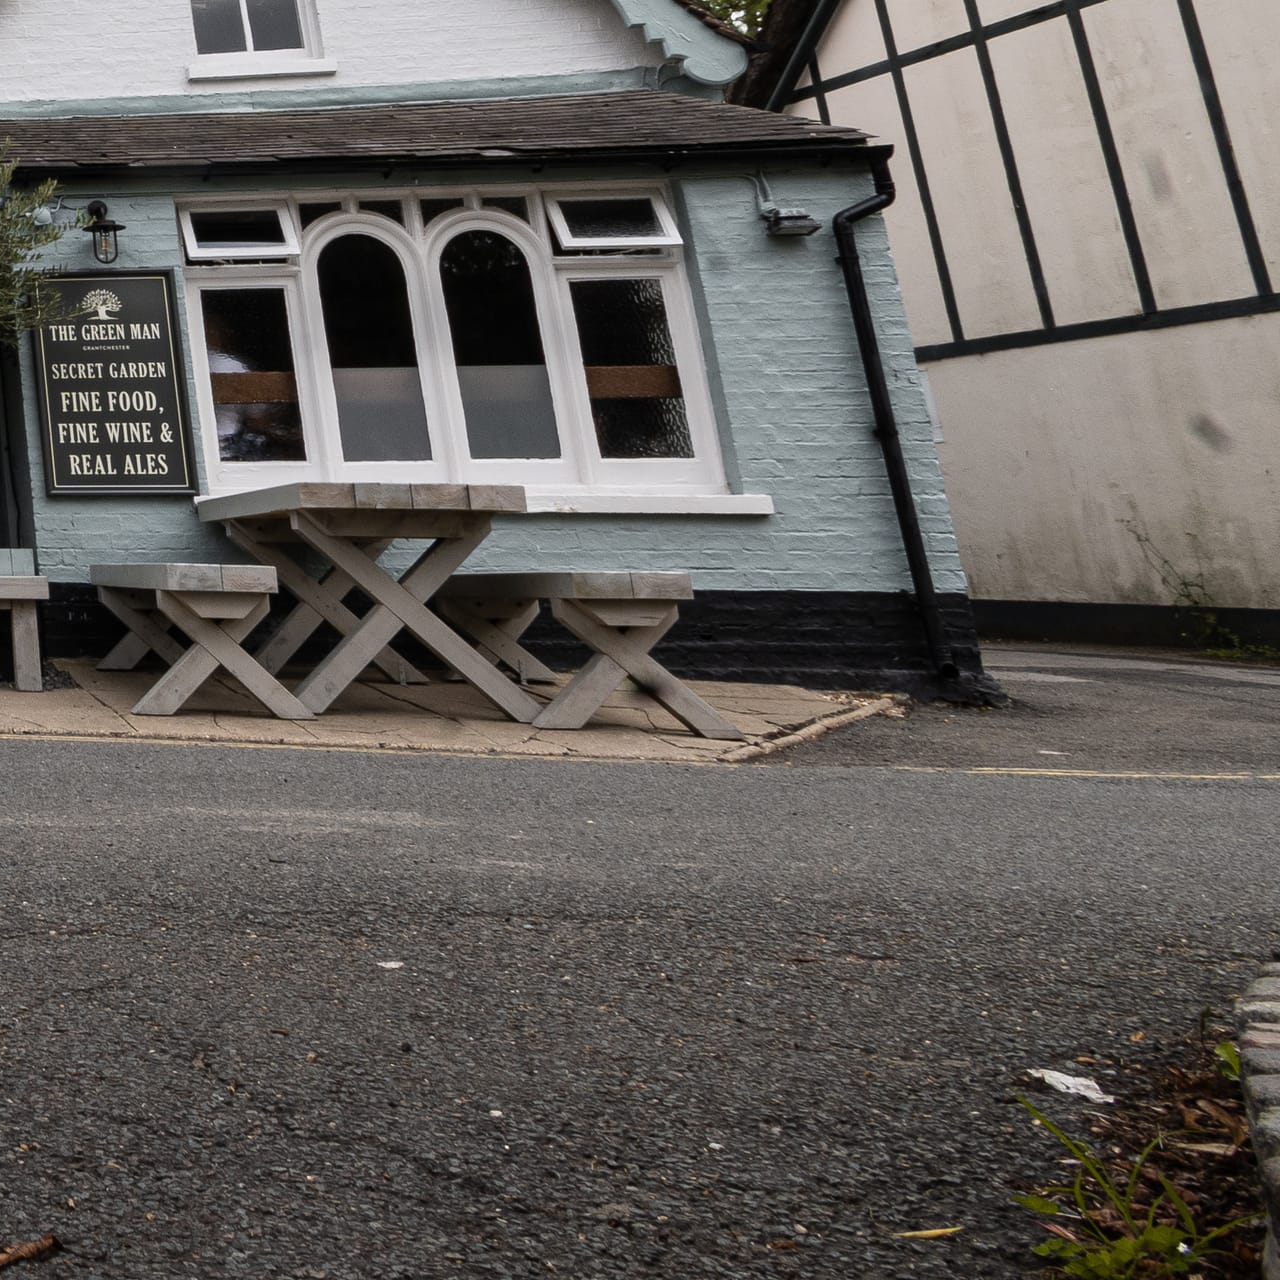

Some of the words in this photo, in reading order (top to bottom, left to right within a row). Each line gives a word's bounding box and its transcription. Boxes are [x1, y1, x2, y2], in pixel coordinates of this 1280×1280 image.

[49, 325, 77, 341] THE
[81, 323, 126, 341] GREEN
[130, 323, 161, 340] MAN
[51, 363, 103, 380] SECRET
[109, 362, 167, 378] GARDEN
[60, 391, 102, 412] FINE
[107, 390, 164, 414] FOOD,
[58, 423, 99, 444] FINE
[105, 422, 153, 443] WINE
[160, 422, 174, 443] &
[69, 454, 117, 475] REAL
[124, 454, 169, 475] ALES
